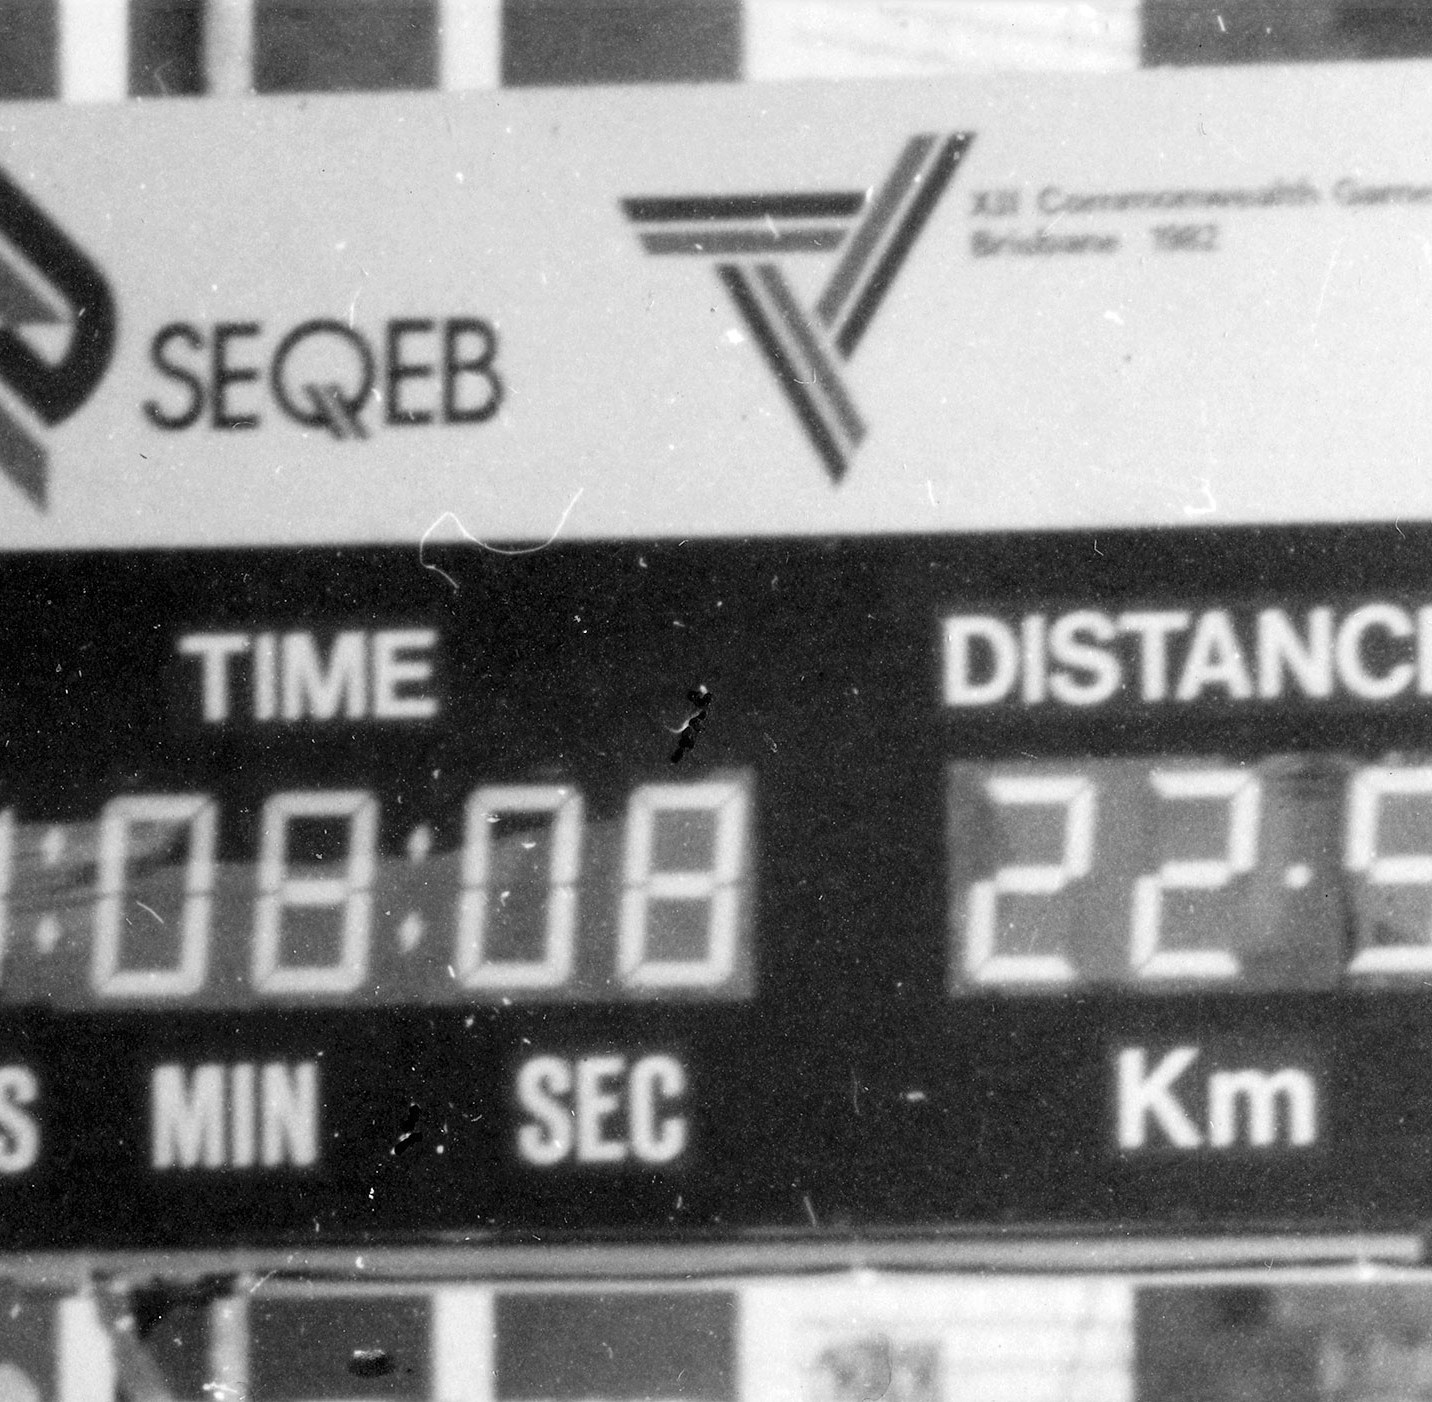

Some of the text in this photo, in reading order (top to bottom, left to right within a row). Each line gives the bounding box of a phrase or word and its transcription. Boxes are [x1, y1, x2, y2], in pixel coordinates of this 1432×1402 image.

[967, 221, 1219, 261] Brisbane 1982
[1033, 178, 1321, 219] Commonwealth
[140, 314, 506, 442] SEQEB
[179, 627, 439, 723] TIME
[150, 1061, 320, 1170] MIN
[515, 1052, 689, 1167] SEC
[1116, 1045, 1319, 1151] Km
